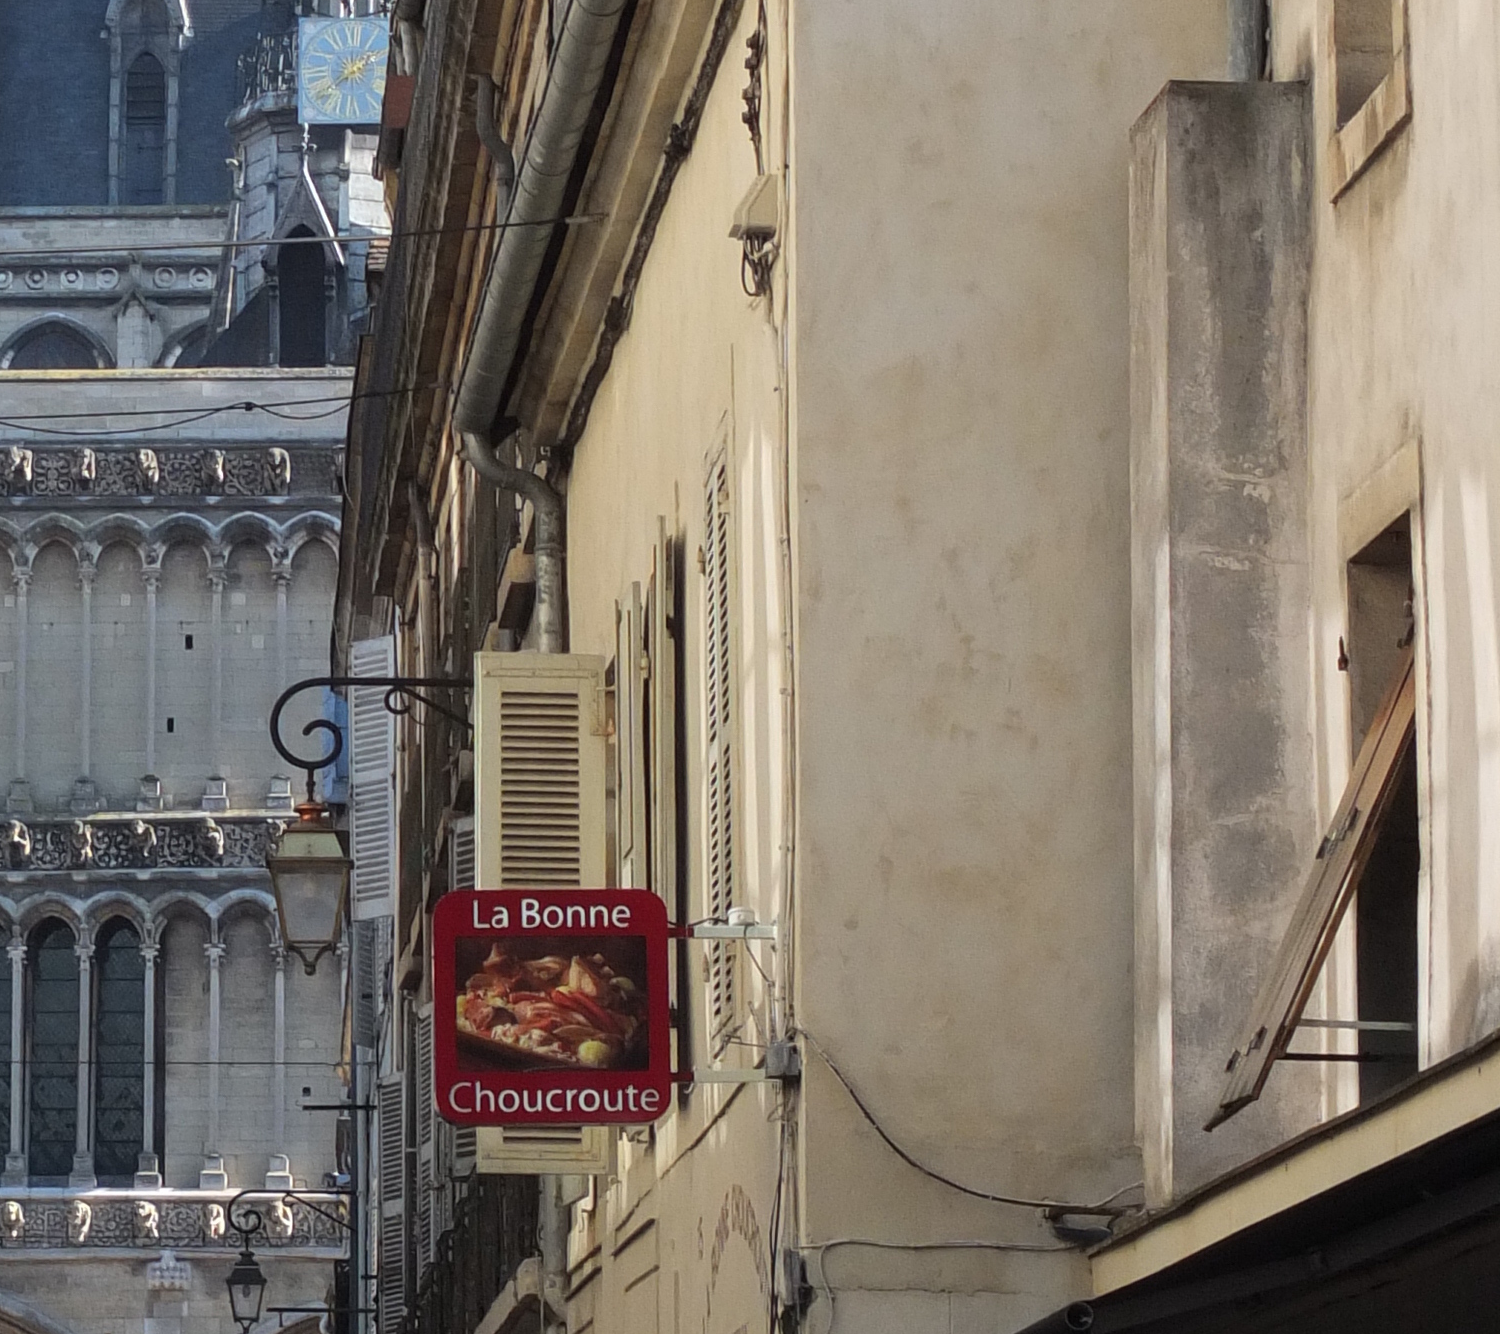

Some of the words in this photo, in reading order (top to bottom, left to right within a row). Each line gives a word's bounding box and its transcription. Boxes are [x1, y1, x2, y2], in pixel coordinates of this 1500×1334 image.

[472, 899, 510, 929] La
[520, 898, 632, 929] Bonne
[448, 1080, 660, 1114] Choucroute
